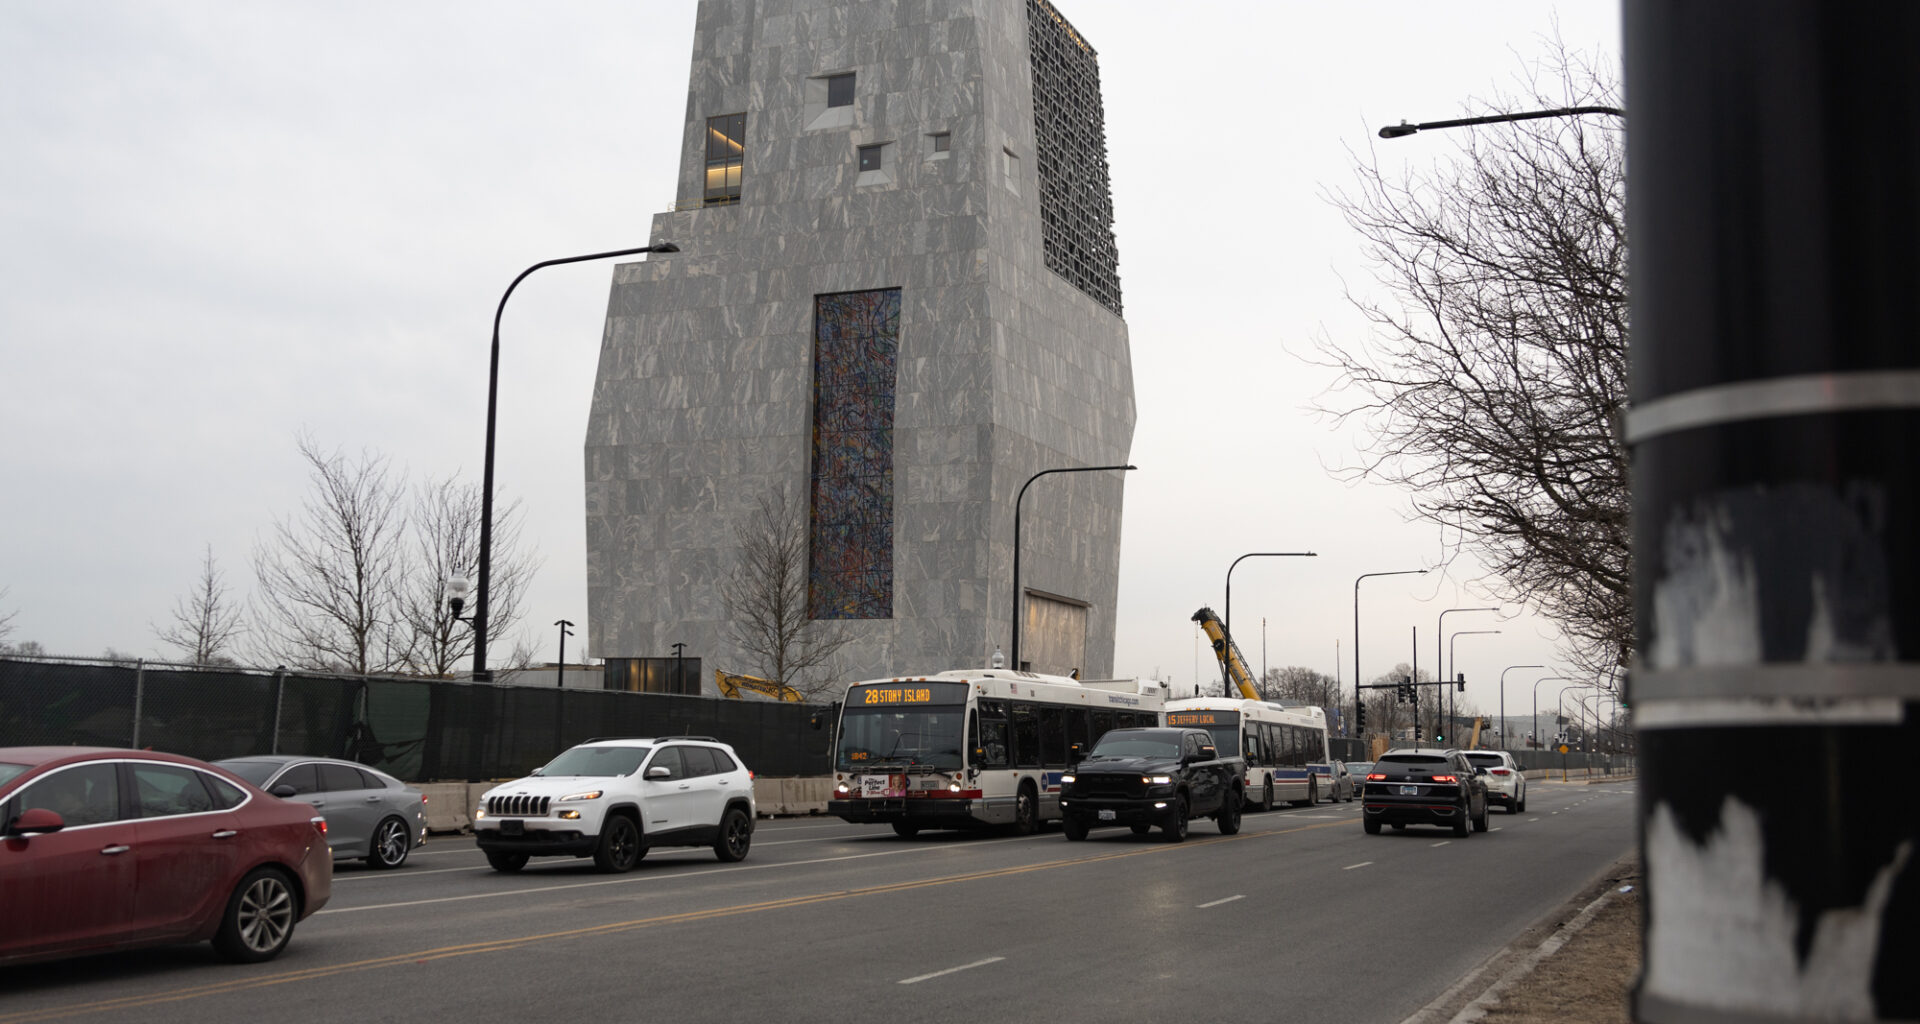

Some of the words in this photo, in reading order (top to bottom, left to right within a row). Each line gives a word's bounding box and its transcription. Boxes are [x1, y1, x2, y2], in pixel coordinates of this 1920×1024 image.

[865, 689, 879, 704] 28
[880, 689, 902, 703] STONY
[904, 688, 930, 702] ISLAND
[1168, 715, 1176, 725] 15
[1199, 714, 1215, 724] LOCAL
